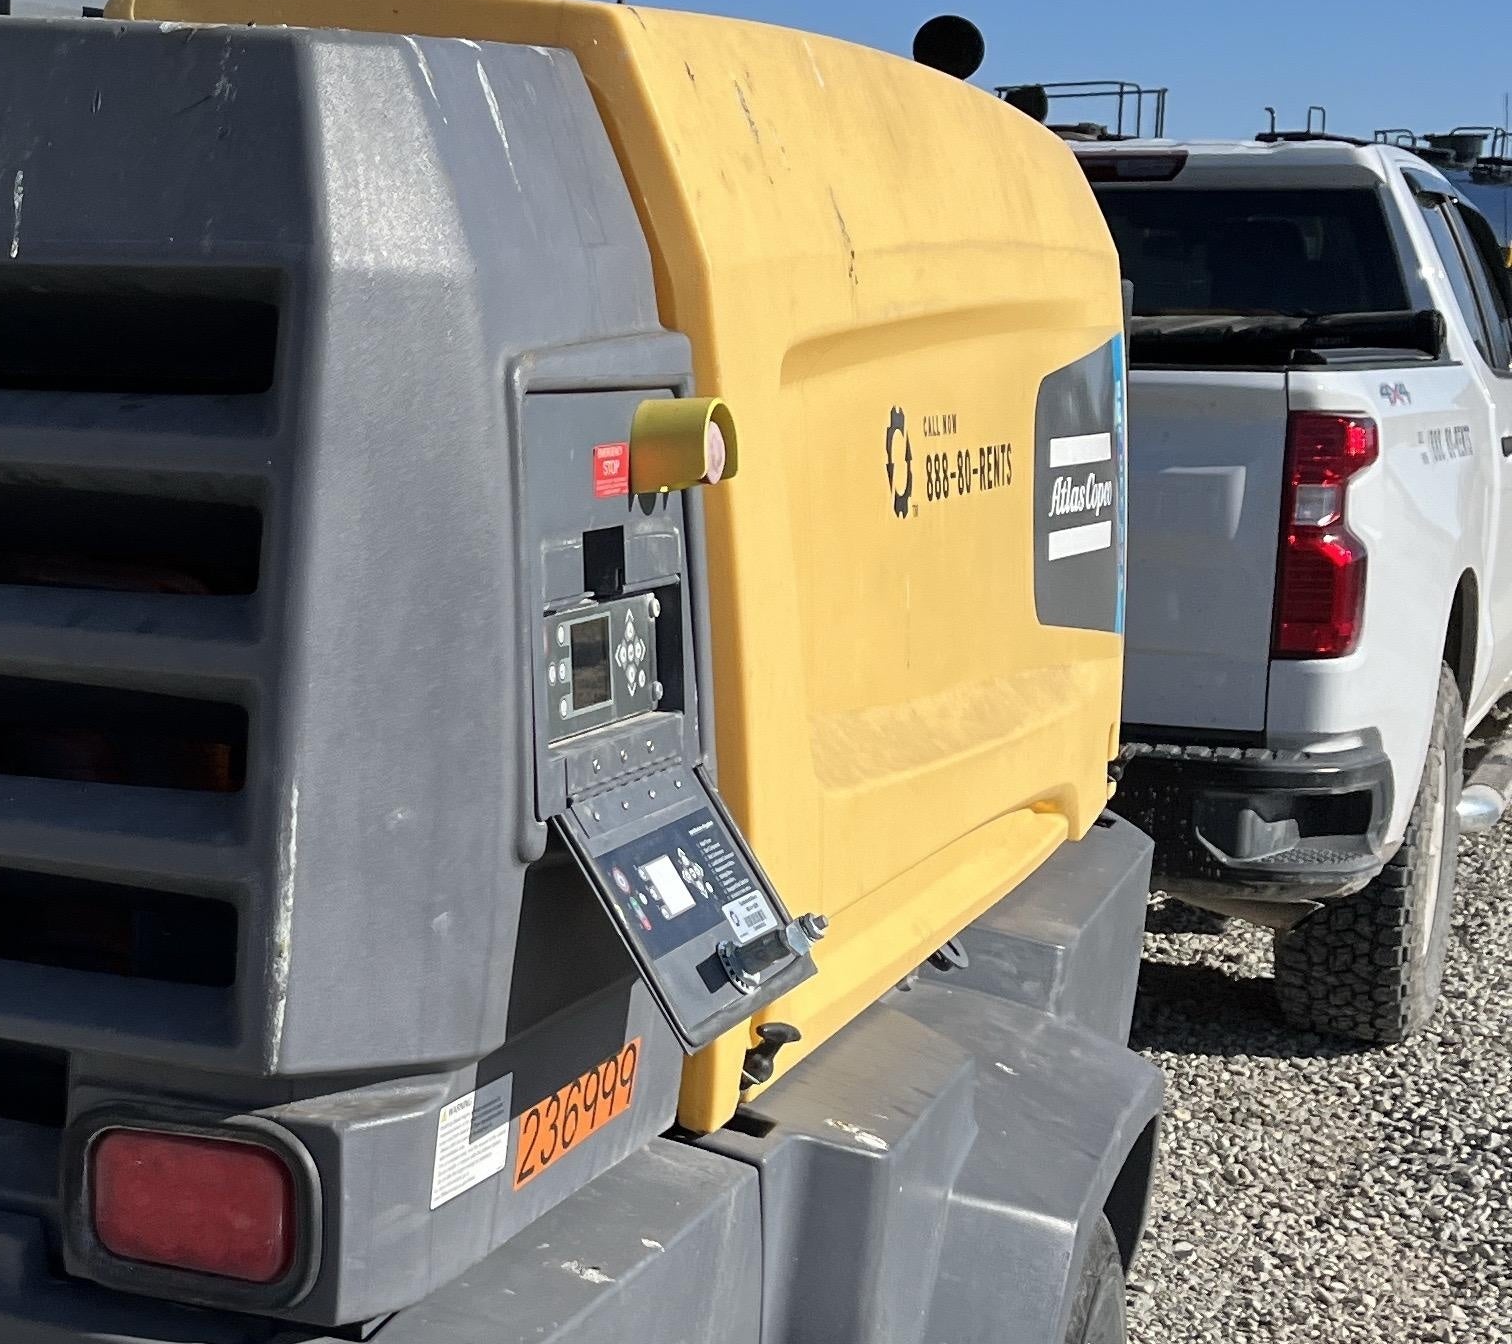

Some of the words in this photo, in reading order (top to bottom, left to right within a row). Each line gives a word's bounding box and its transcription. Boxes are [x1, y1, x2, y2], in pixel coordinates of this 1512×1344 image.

[923, 416, 940, 437] CALL
[942, 414, 957, 434] NOW
[926, 443, 1012, 502] 888-80-RENTS
[1048, 476, 1085, 517] Atlas
[517, 1043, 638, 1184] 236999
